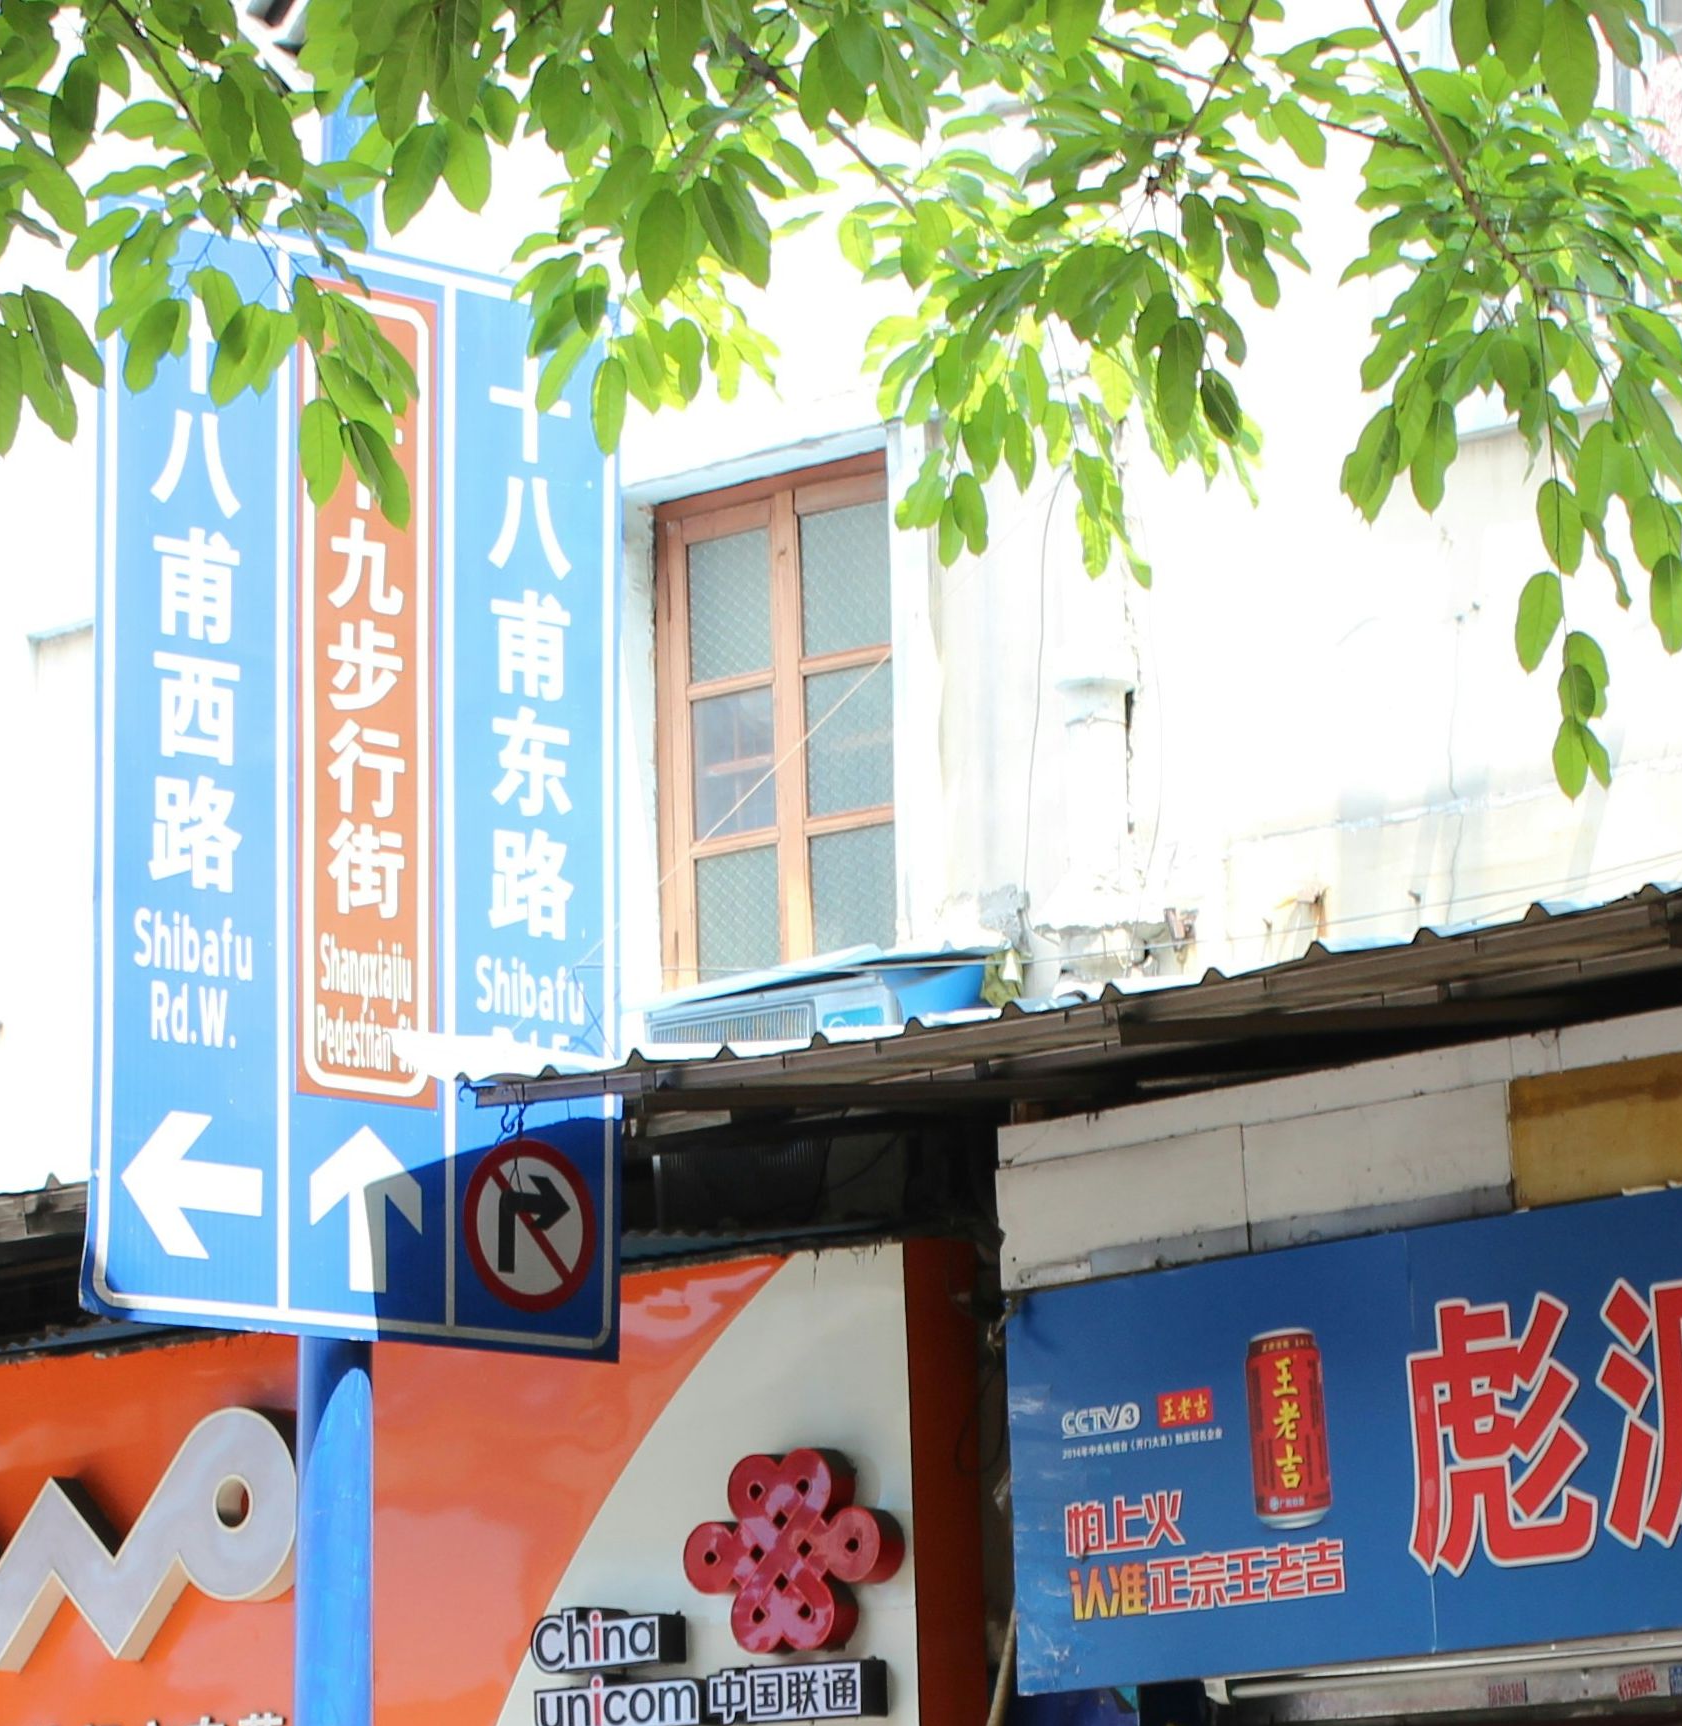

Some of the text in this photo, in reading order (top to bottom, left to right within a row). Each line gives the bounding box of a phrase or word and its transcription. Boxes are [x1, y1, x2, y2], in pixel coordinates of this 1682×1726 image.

[327, 430, 406, 918] 九步行街
[134, 906, 254, 983] Shibafu
[319, 933, 413, 1013] Shangxiajiu
[149, 981, 238, 1049] Rd.W.
[475, 955, 585, 1026] Shibafu
[316, 1005, 392, 1073] Pedestrian
[1160, 1390, 1210, 1425] 王老吉
[1271, 1356, 1305, 1492] 王老吉
[1064, 1489, 1186, 1558] 怕上火
[1069, 1539, 1346, 1622] 认准正宗王老吉
[534, 1609, 658, 1672] China
[709, 1667, 860, 1723] 中国联通
